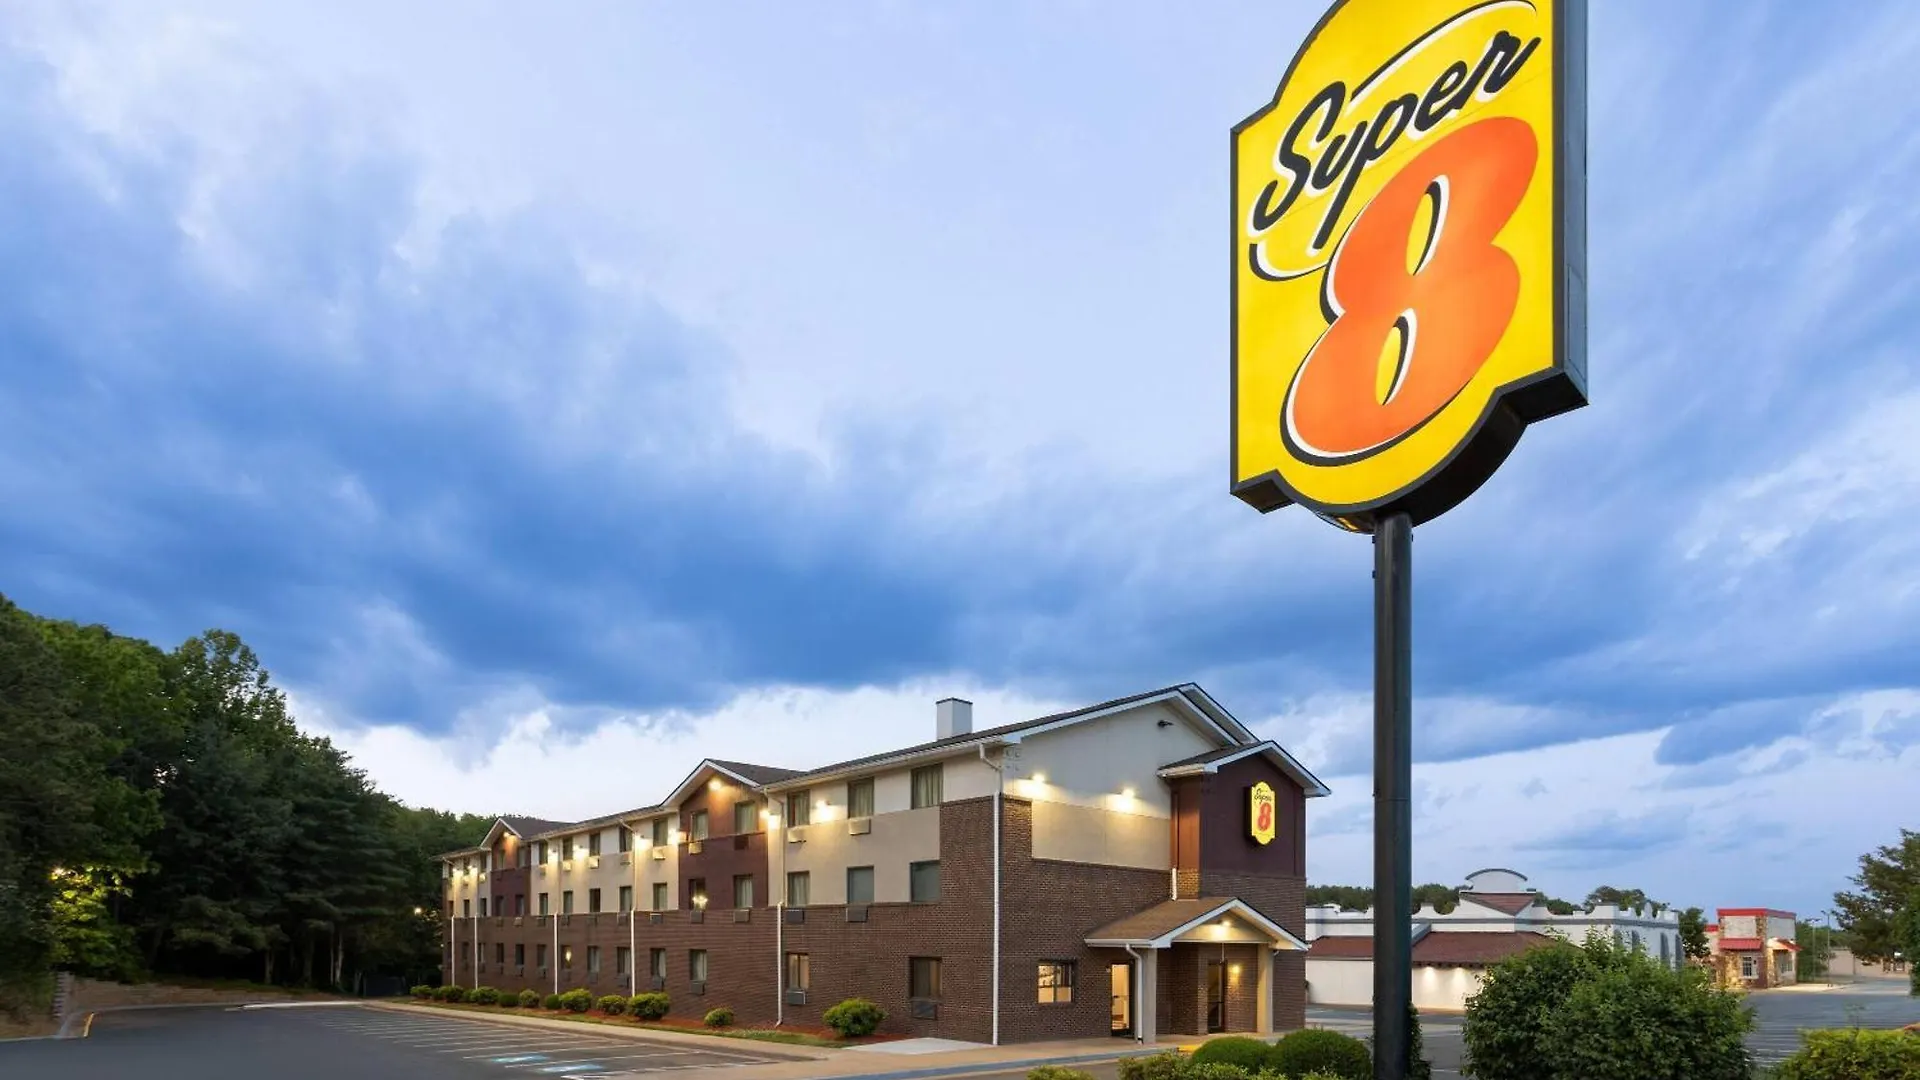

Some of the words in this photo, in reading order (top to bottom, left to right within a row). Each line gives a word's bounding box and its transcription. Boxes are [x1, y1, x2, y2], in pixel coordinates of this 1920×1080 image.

[1250, 30, 1541, 253] Super
[1280, 116, 1538, 467] 8
[1258, 802, 1271, 831] 8
